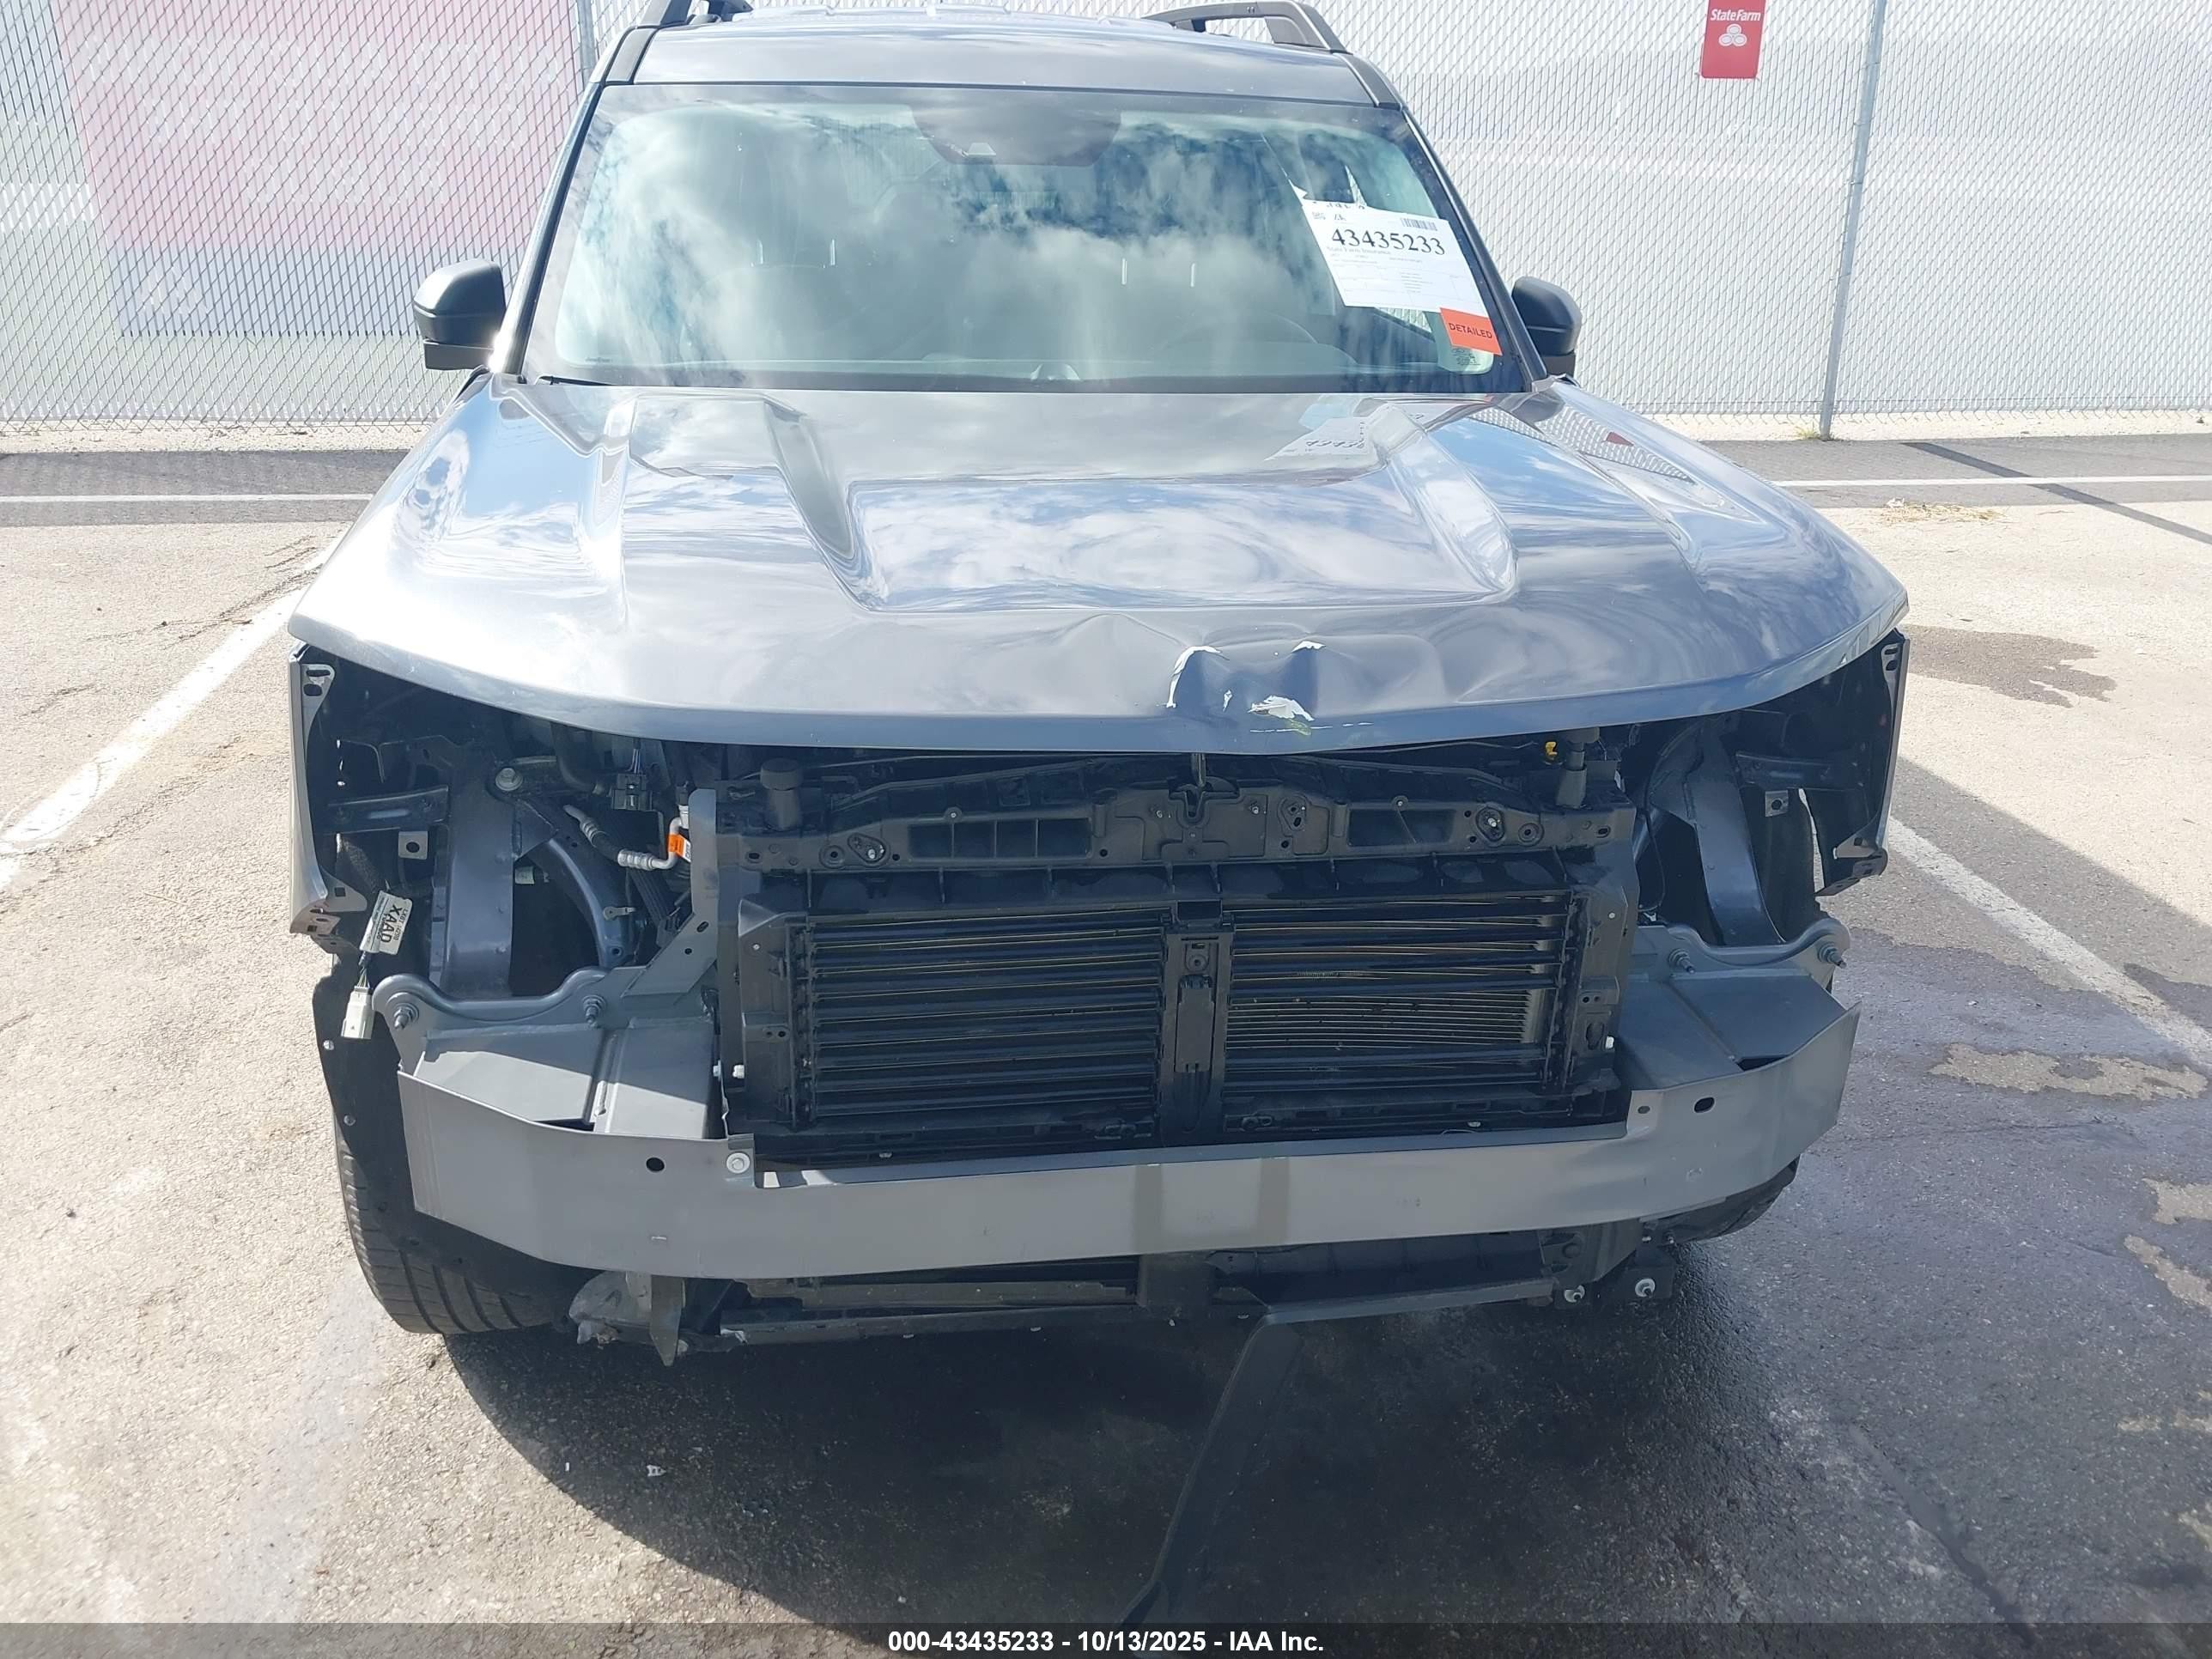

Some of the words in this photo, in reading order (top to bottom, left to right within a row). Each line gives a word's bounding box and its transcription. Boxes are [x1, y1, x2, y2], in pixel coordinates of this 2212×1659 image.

[1332, 228, 1445, 255] 43435233
[1448, 322, 1493, 338] DETAILED
[380, 904, 403, 943] XAAD
